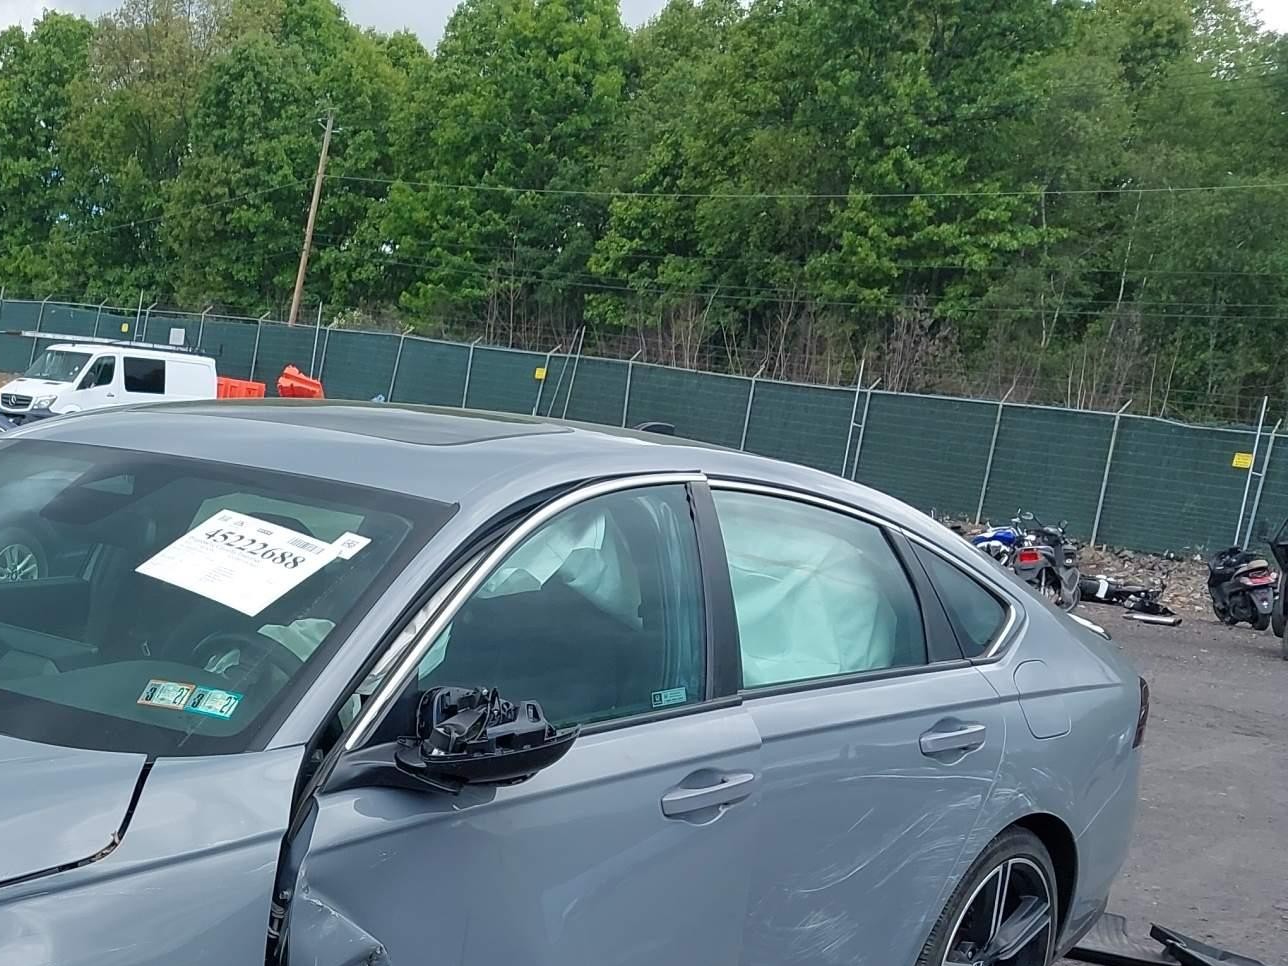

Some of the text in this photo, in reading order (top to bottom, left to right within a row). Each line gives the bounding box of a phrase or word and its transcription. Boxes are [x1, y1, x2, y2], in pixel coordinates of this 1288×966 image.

[204, 528, 306, 569] 45222688
[145, 686, 191, 705] 3 27
[192, 693, 239, 715] 3 27
